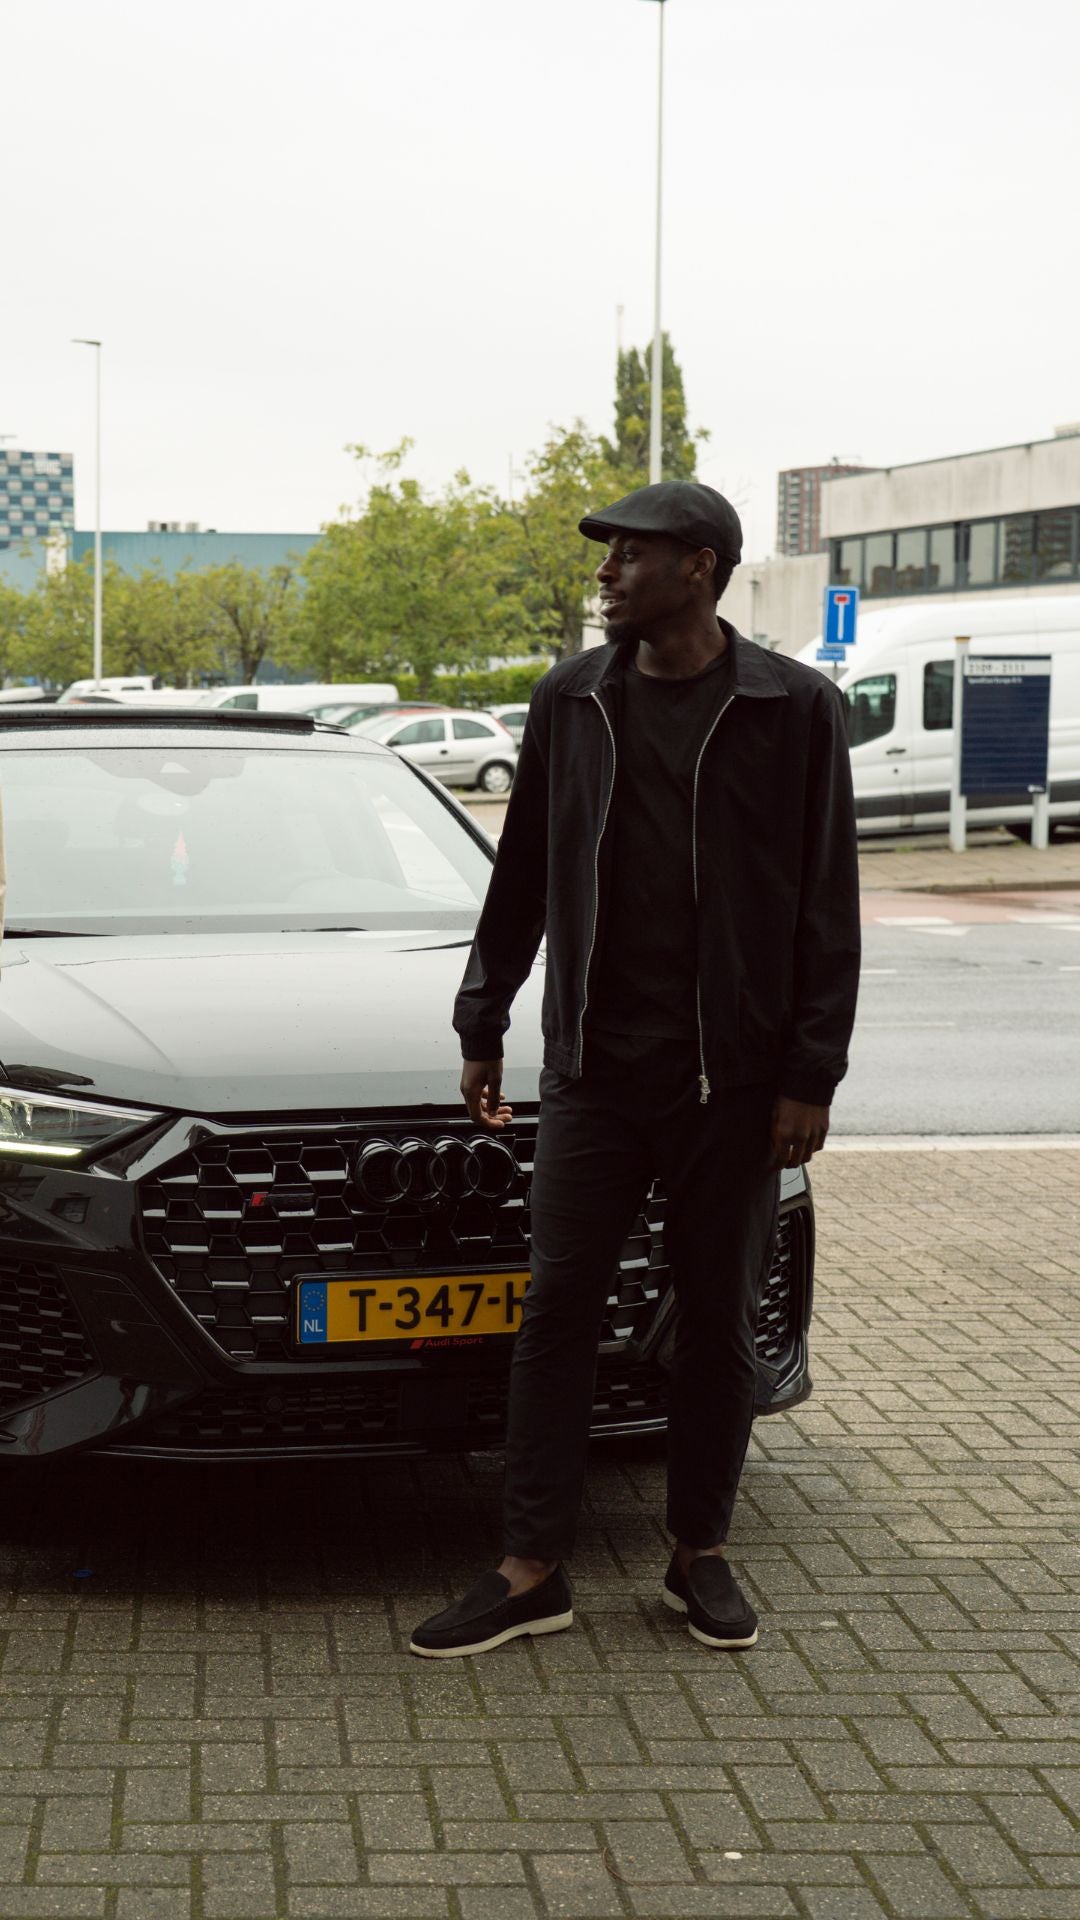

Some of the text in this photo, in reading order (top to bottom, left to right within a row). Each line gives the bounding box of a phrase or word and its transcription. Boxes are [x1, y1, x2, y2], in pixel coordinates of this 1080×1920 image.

[303, 1319, 324, 1333] NL
[425, 1337, 485, 1347] Audi Sport
